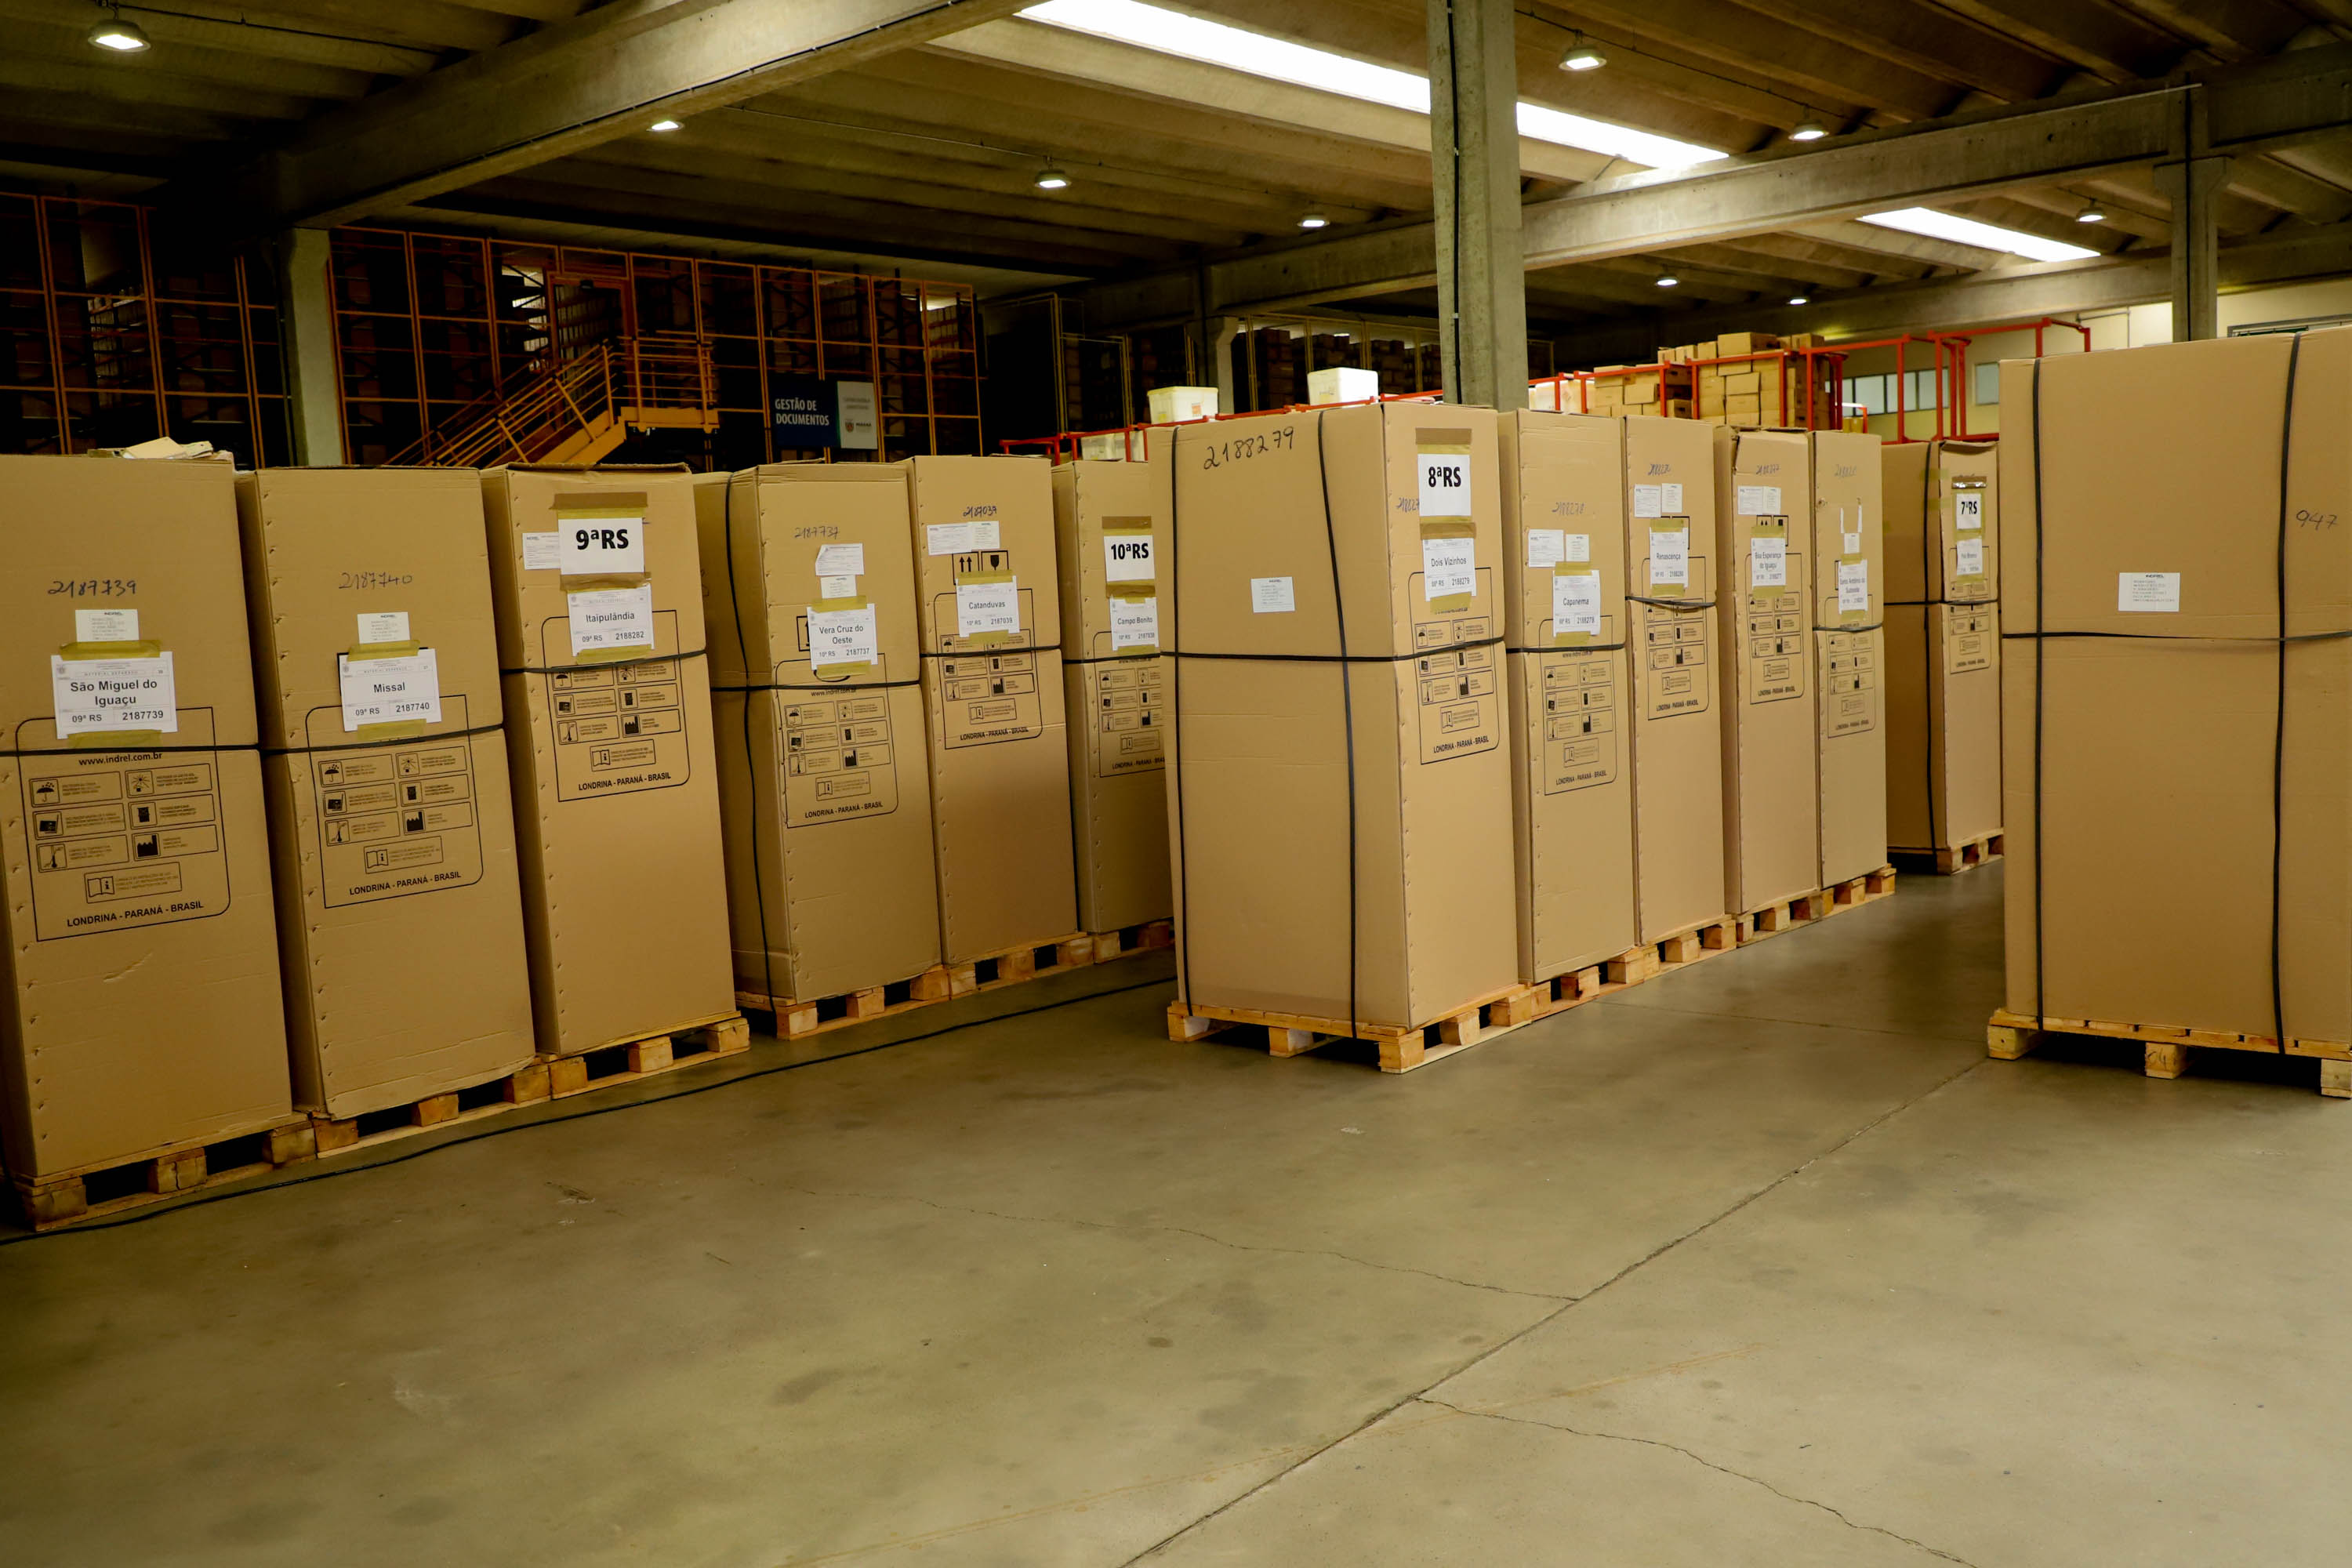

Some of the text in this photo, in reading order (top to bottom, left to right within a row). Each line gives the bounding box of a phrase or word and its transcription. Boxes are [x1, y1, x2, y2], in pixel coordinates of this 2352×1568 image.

[775, 397, 817, 411] GESTÃO DE
[775, 413, 829, 426] DOCUMENTOS
[1203, 426, 1294, 470] 2188279
[2296, 509, 2339, 531] 947
[1431, 555, 1467, 567] Dois Vizinhos
[338, 572, 413, 590] 2187740
[47, 579, 138, 598] 2187739
[968, 601, 1006, 610] Catanduvas
[586, 611, 635, 624] Itaipulândia
[1117, 617, 1136, 626] Campo
[615, 630, 644, 641] 2188282
[837, 625, 854, 633] Cruz
[832, 636, 853, 644] Oeste
[70, 679, 158, 692] São Miguel do
[373, 681, 406, 693] Missal
[95, 695, 136, 708] Iguaçu
[395, 702, 430, 713] 2187740
[89, 713, 103, 722] RS
[122, 710, 164, 721] 2187739
[78, 752, 163, 766] www.indrel.com.br
[579, 779, 612, 791] LONDRINA
[617, 772, 643, 787] PARANÁ
[648, 771, 672, 782] BRASIL
[804, 807, 833, 819] LONDRINA
[837, 801, 860, 815] PARANÁ
[864, 800, 884, 811] BRASIL
[350, 882, 390, 895] LONDRINA
[396, 875, 428, 888] PARANÁ
[434, 871, 461, 881] BRASIL
[67, 913, 117, 927] LONDRINA
[124, 905, 163, 920] PARANÁ
[171, 899, 204, 913] BRASIL
